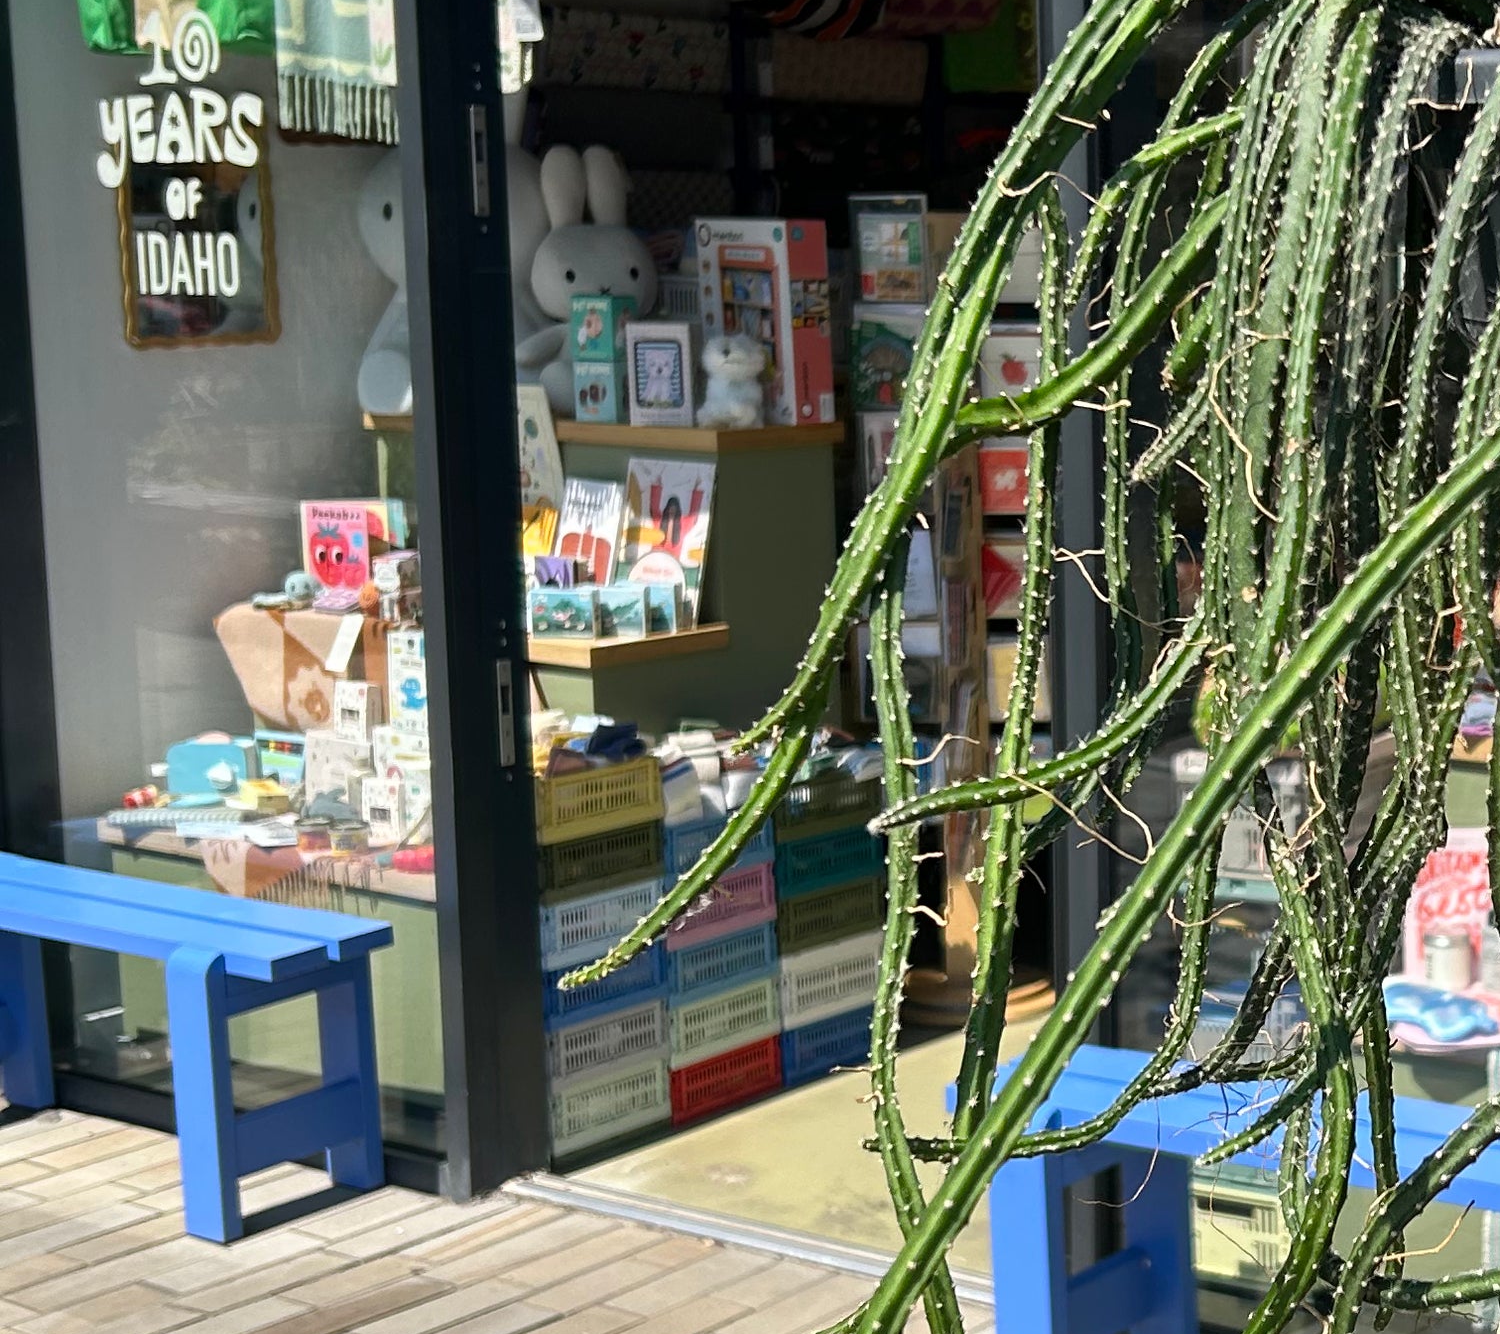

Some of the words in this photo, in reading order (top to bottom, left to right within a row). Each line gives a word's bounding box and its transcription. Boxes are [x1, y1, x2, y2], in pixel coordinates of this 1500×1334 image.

[139, 9, 221, 85] 10
[97, 87, 264, 189] YEARS
[165, 177, 203, 220] OF
[135, 230, 241, 298] IDAHO
